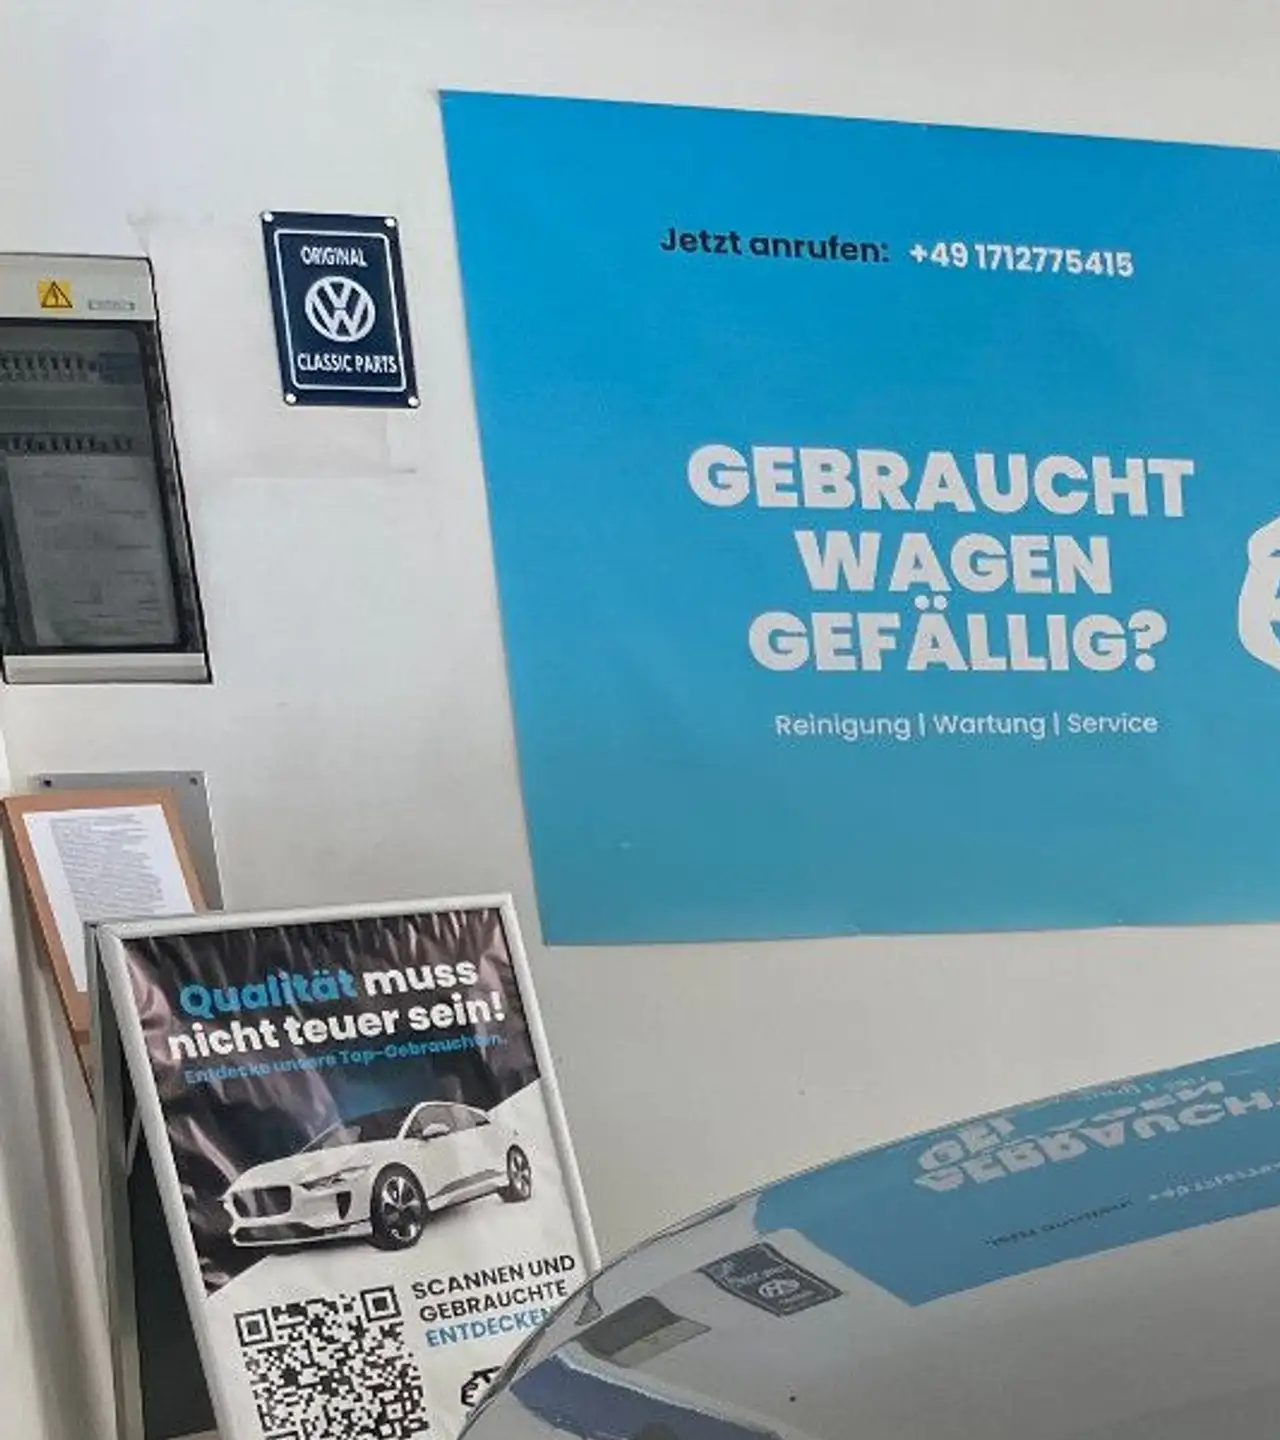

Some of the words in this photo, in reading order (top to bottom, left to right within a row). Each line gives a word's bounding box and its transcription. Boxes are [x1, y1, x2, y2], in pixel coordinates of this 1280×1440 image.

[301, 246, 368, 267] ORIGINAL
[660, 228, 742, 255] Jetzt
[748, 235, 890, 263] anrufen:
[909, 243, 968, 268] +49
[974, 245, 1134, 277] 1712775415
[298, 353, 351, 372] CLASSIC
[355, 355, 397, 373] PARTS
[687, 443, 1195, 518] GEBRAUCHT
[794, 530, 1113, 594] WAGEN
[748, 595, 1168, 672] GEFÄLLIG?
[775, 713, 911, 740] Reinigung
[932, 714, 1046, 737] Wartung
[1067, 713, 1159, 735] Service
[180, 968, 358, 1020] Qualität
[363, 961, 479, 997] muss
[168, 1018, 281, 1060] nicht
[284, 1007, 400, 1046] teuer
[407, 990, 506, 1032] sein!
[411, 1263, 525, 1300] SCANNEN
[528, 1254, 576, 1277] UND
[419, 1279, 568, 1323] GEBRAUCHTE
